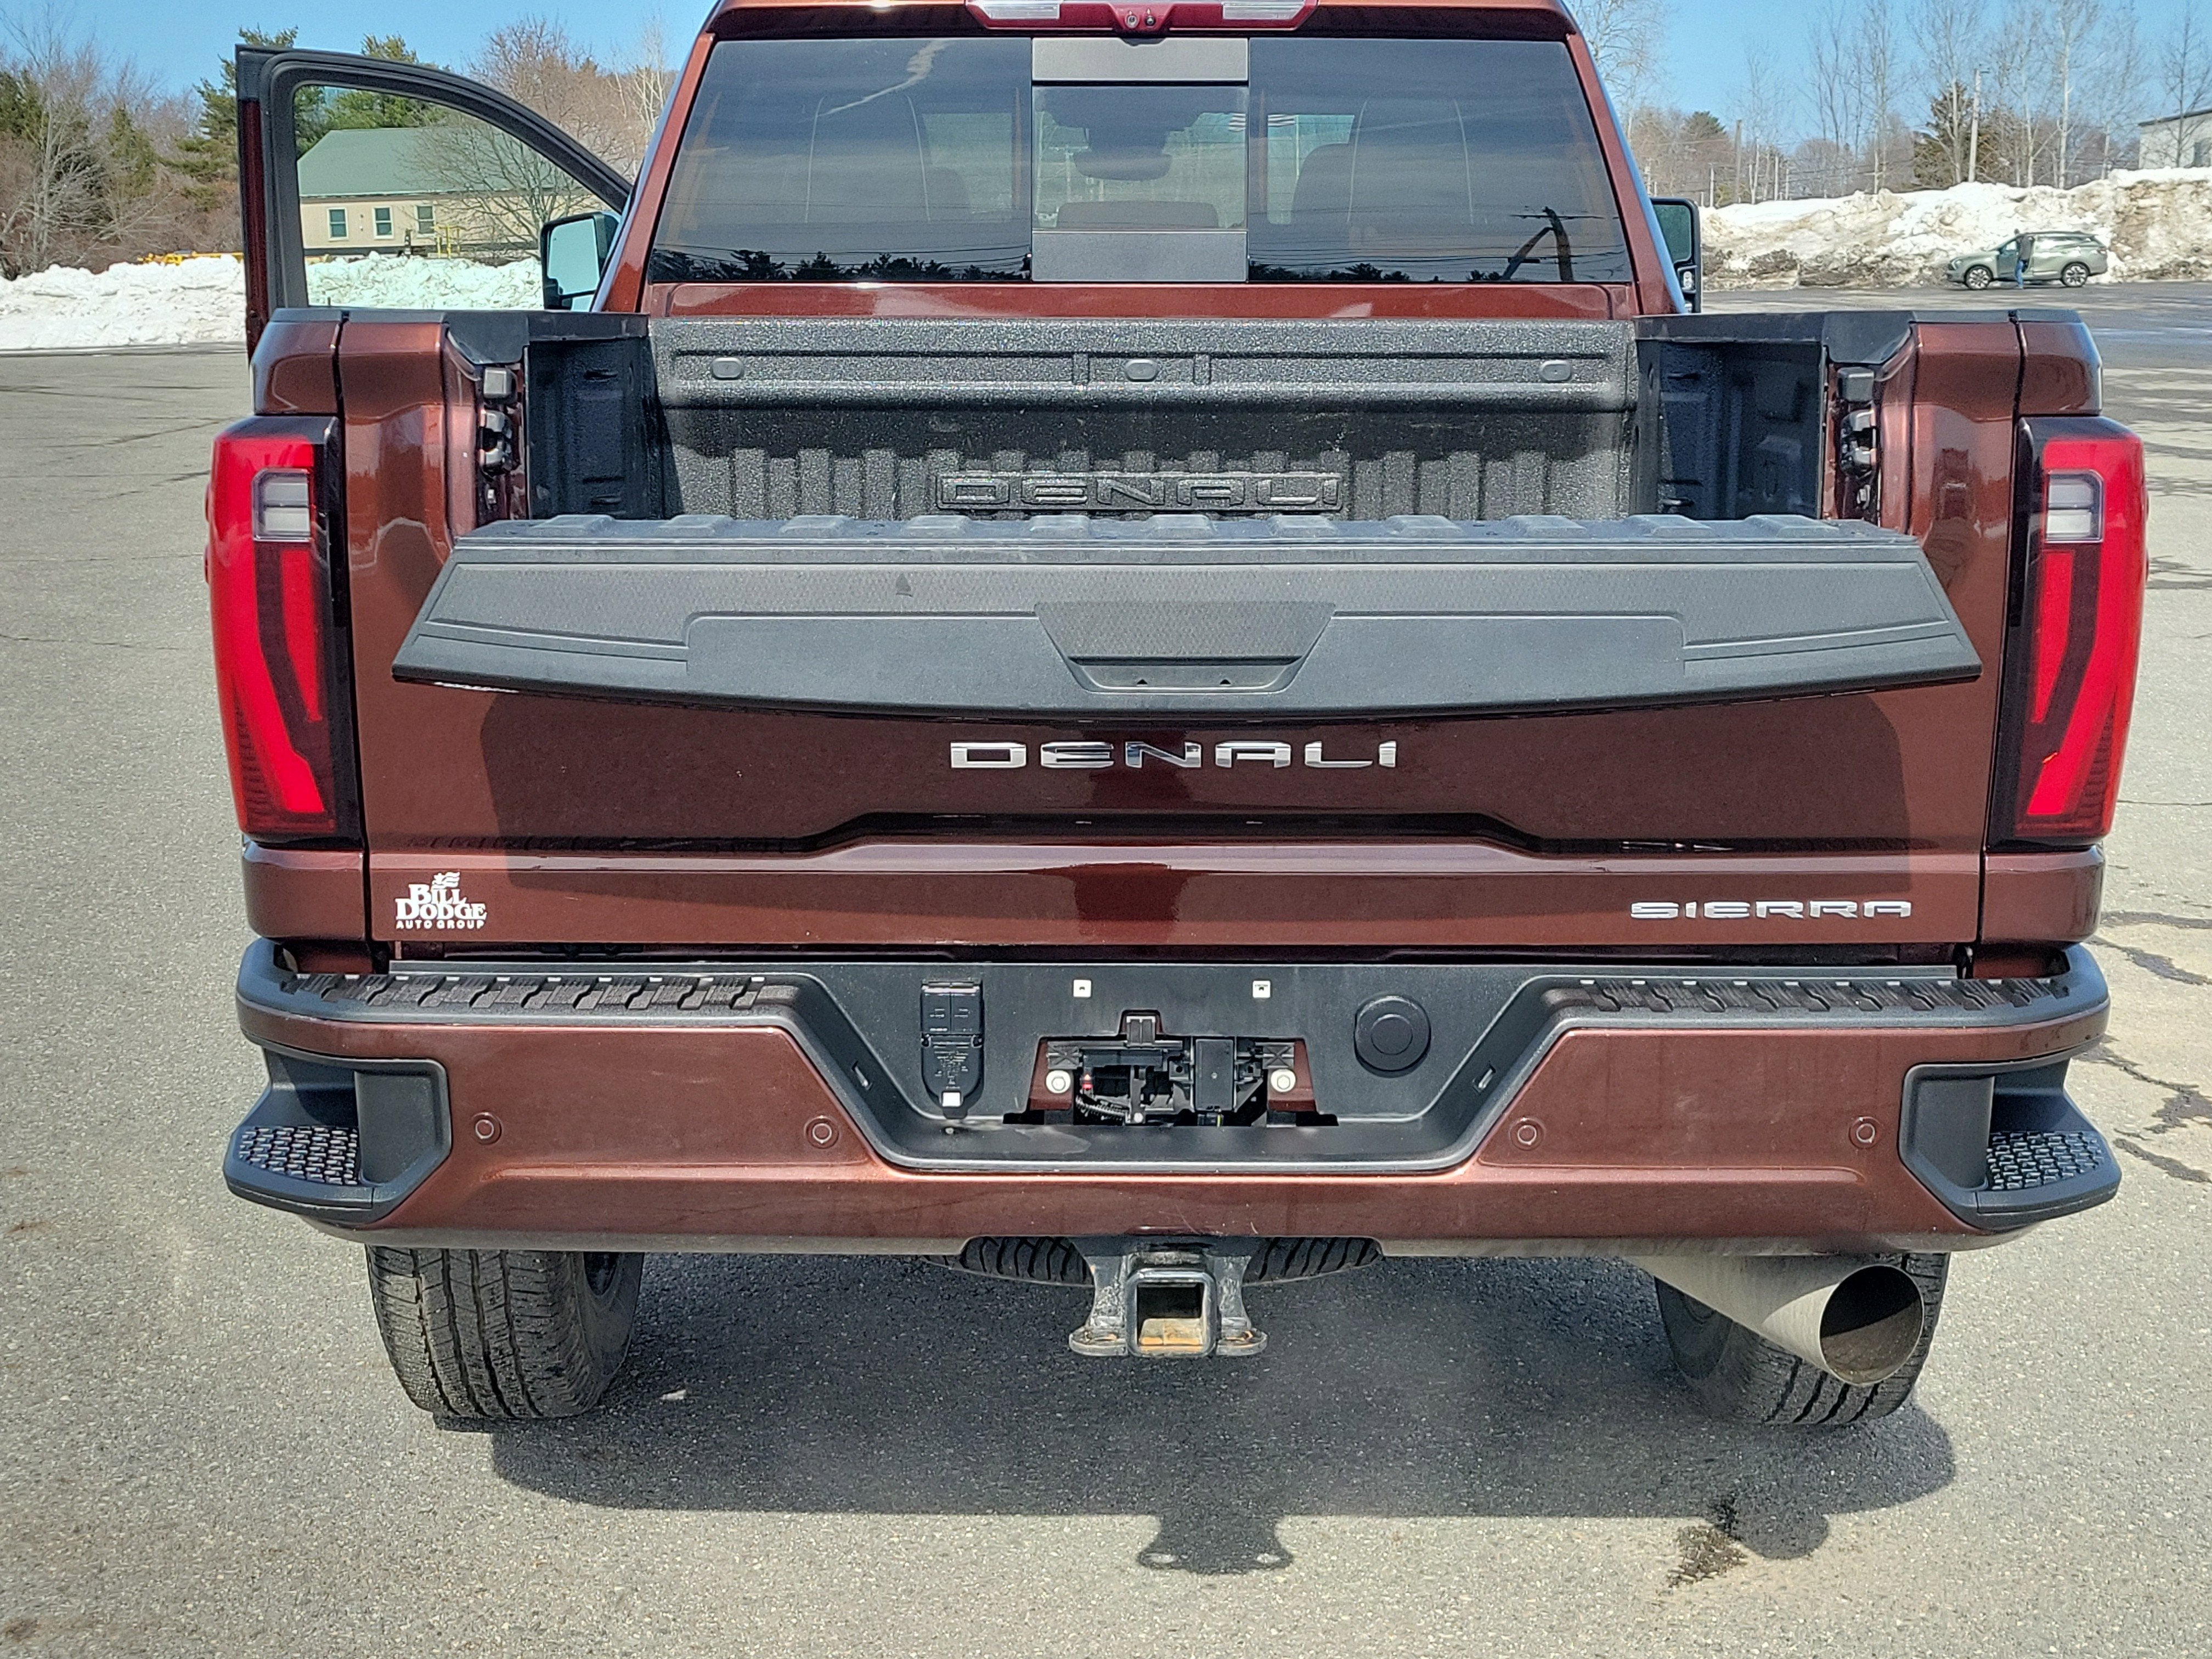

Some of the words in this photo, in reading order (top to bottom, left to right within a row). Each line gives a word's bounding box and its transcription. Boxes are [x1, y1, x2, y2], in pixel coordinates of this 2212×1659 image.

[940, 477, 1339, 506] DENALI
[950, 740, 1397, 769] DENALI
[394, 898, 488, 921] DODGE
[1630, 900, 1912, 919] SIERRA
[396, 919, 433, 929] AUTO
[436, 919, 485, 929] GROUP
